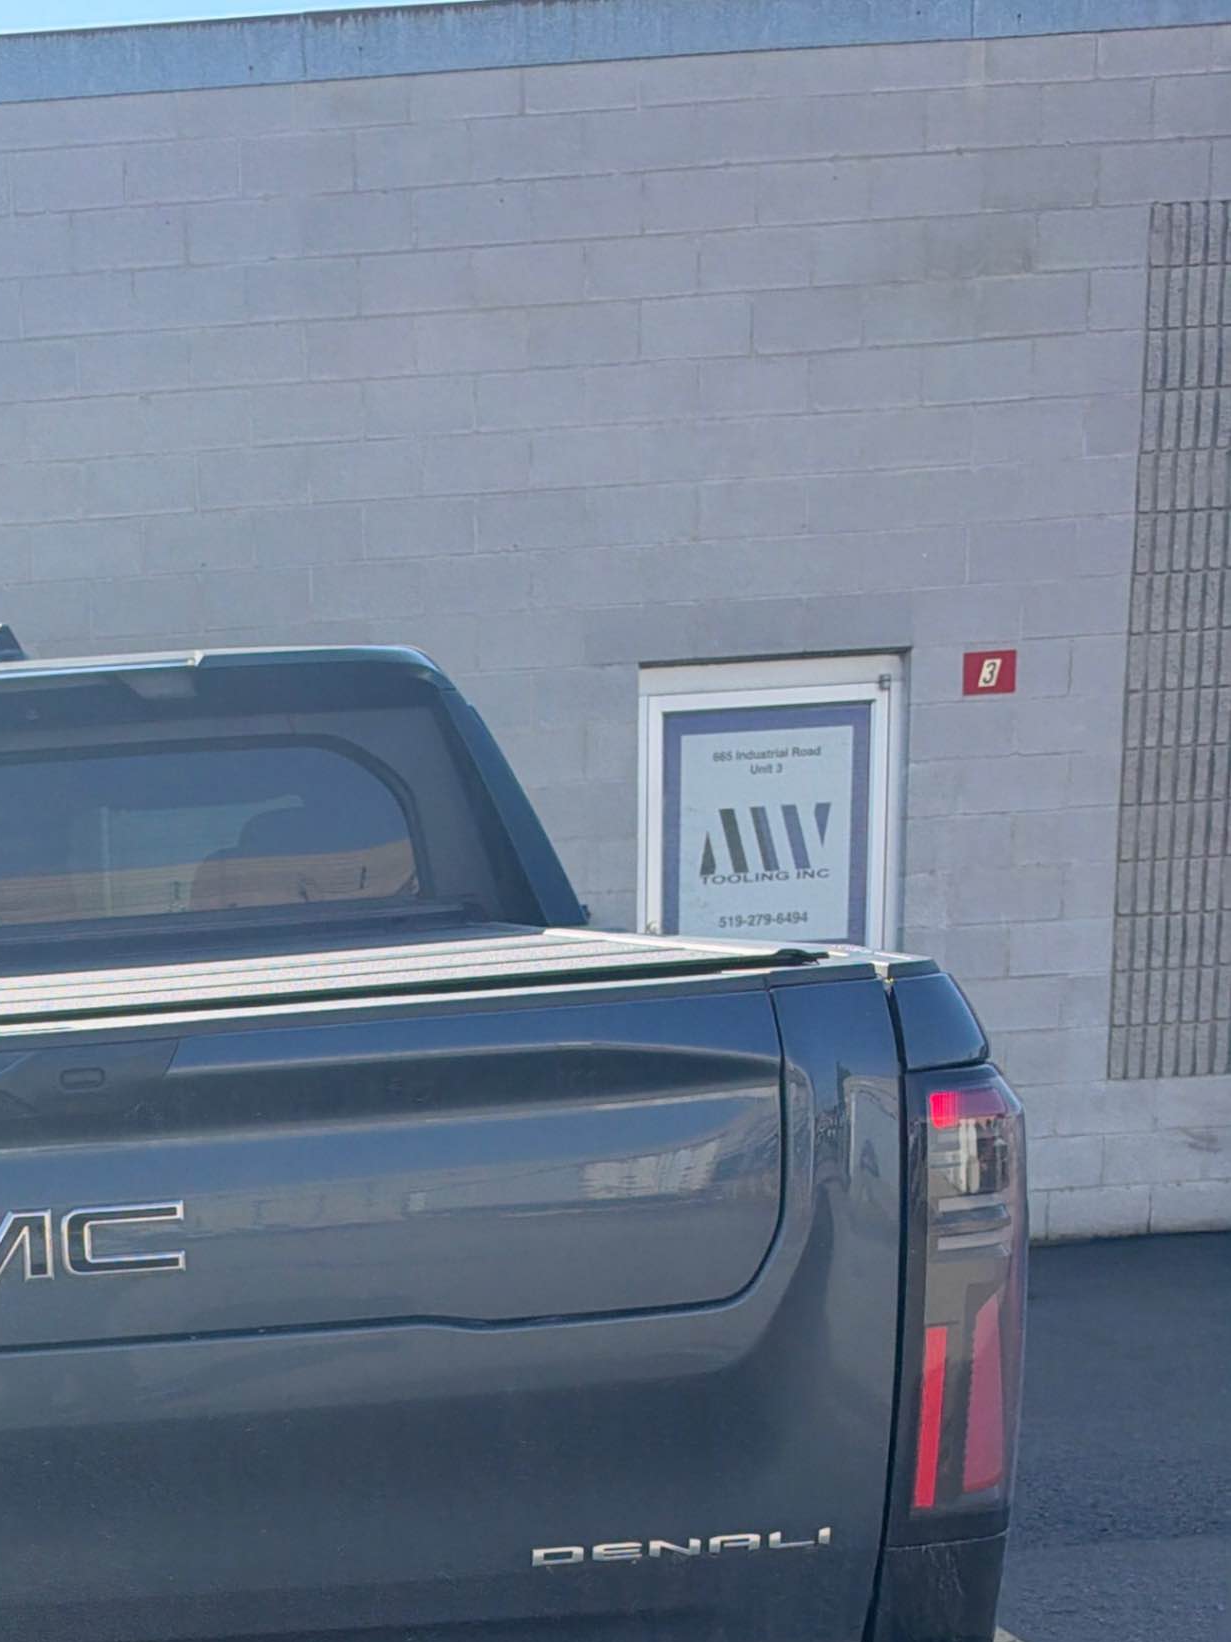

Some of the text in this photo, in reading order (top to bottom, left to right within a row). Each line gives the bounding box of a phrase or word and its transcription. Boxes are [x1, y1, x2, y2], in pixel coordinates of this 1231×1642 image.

[982, 661, 997, 684] 3
[736, 747, 788, 760] Industrial
[792, 745, 821, 757] Road
[750, 763, 783, 775] Unit 3
[702, 868, 830, 885] TOOLING INC
[532, 1527, 831, 1567] DENALI
